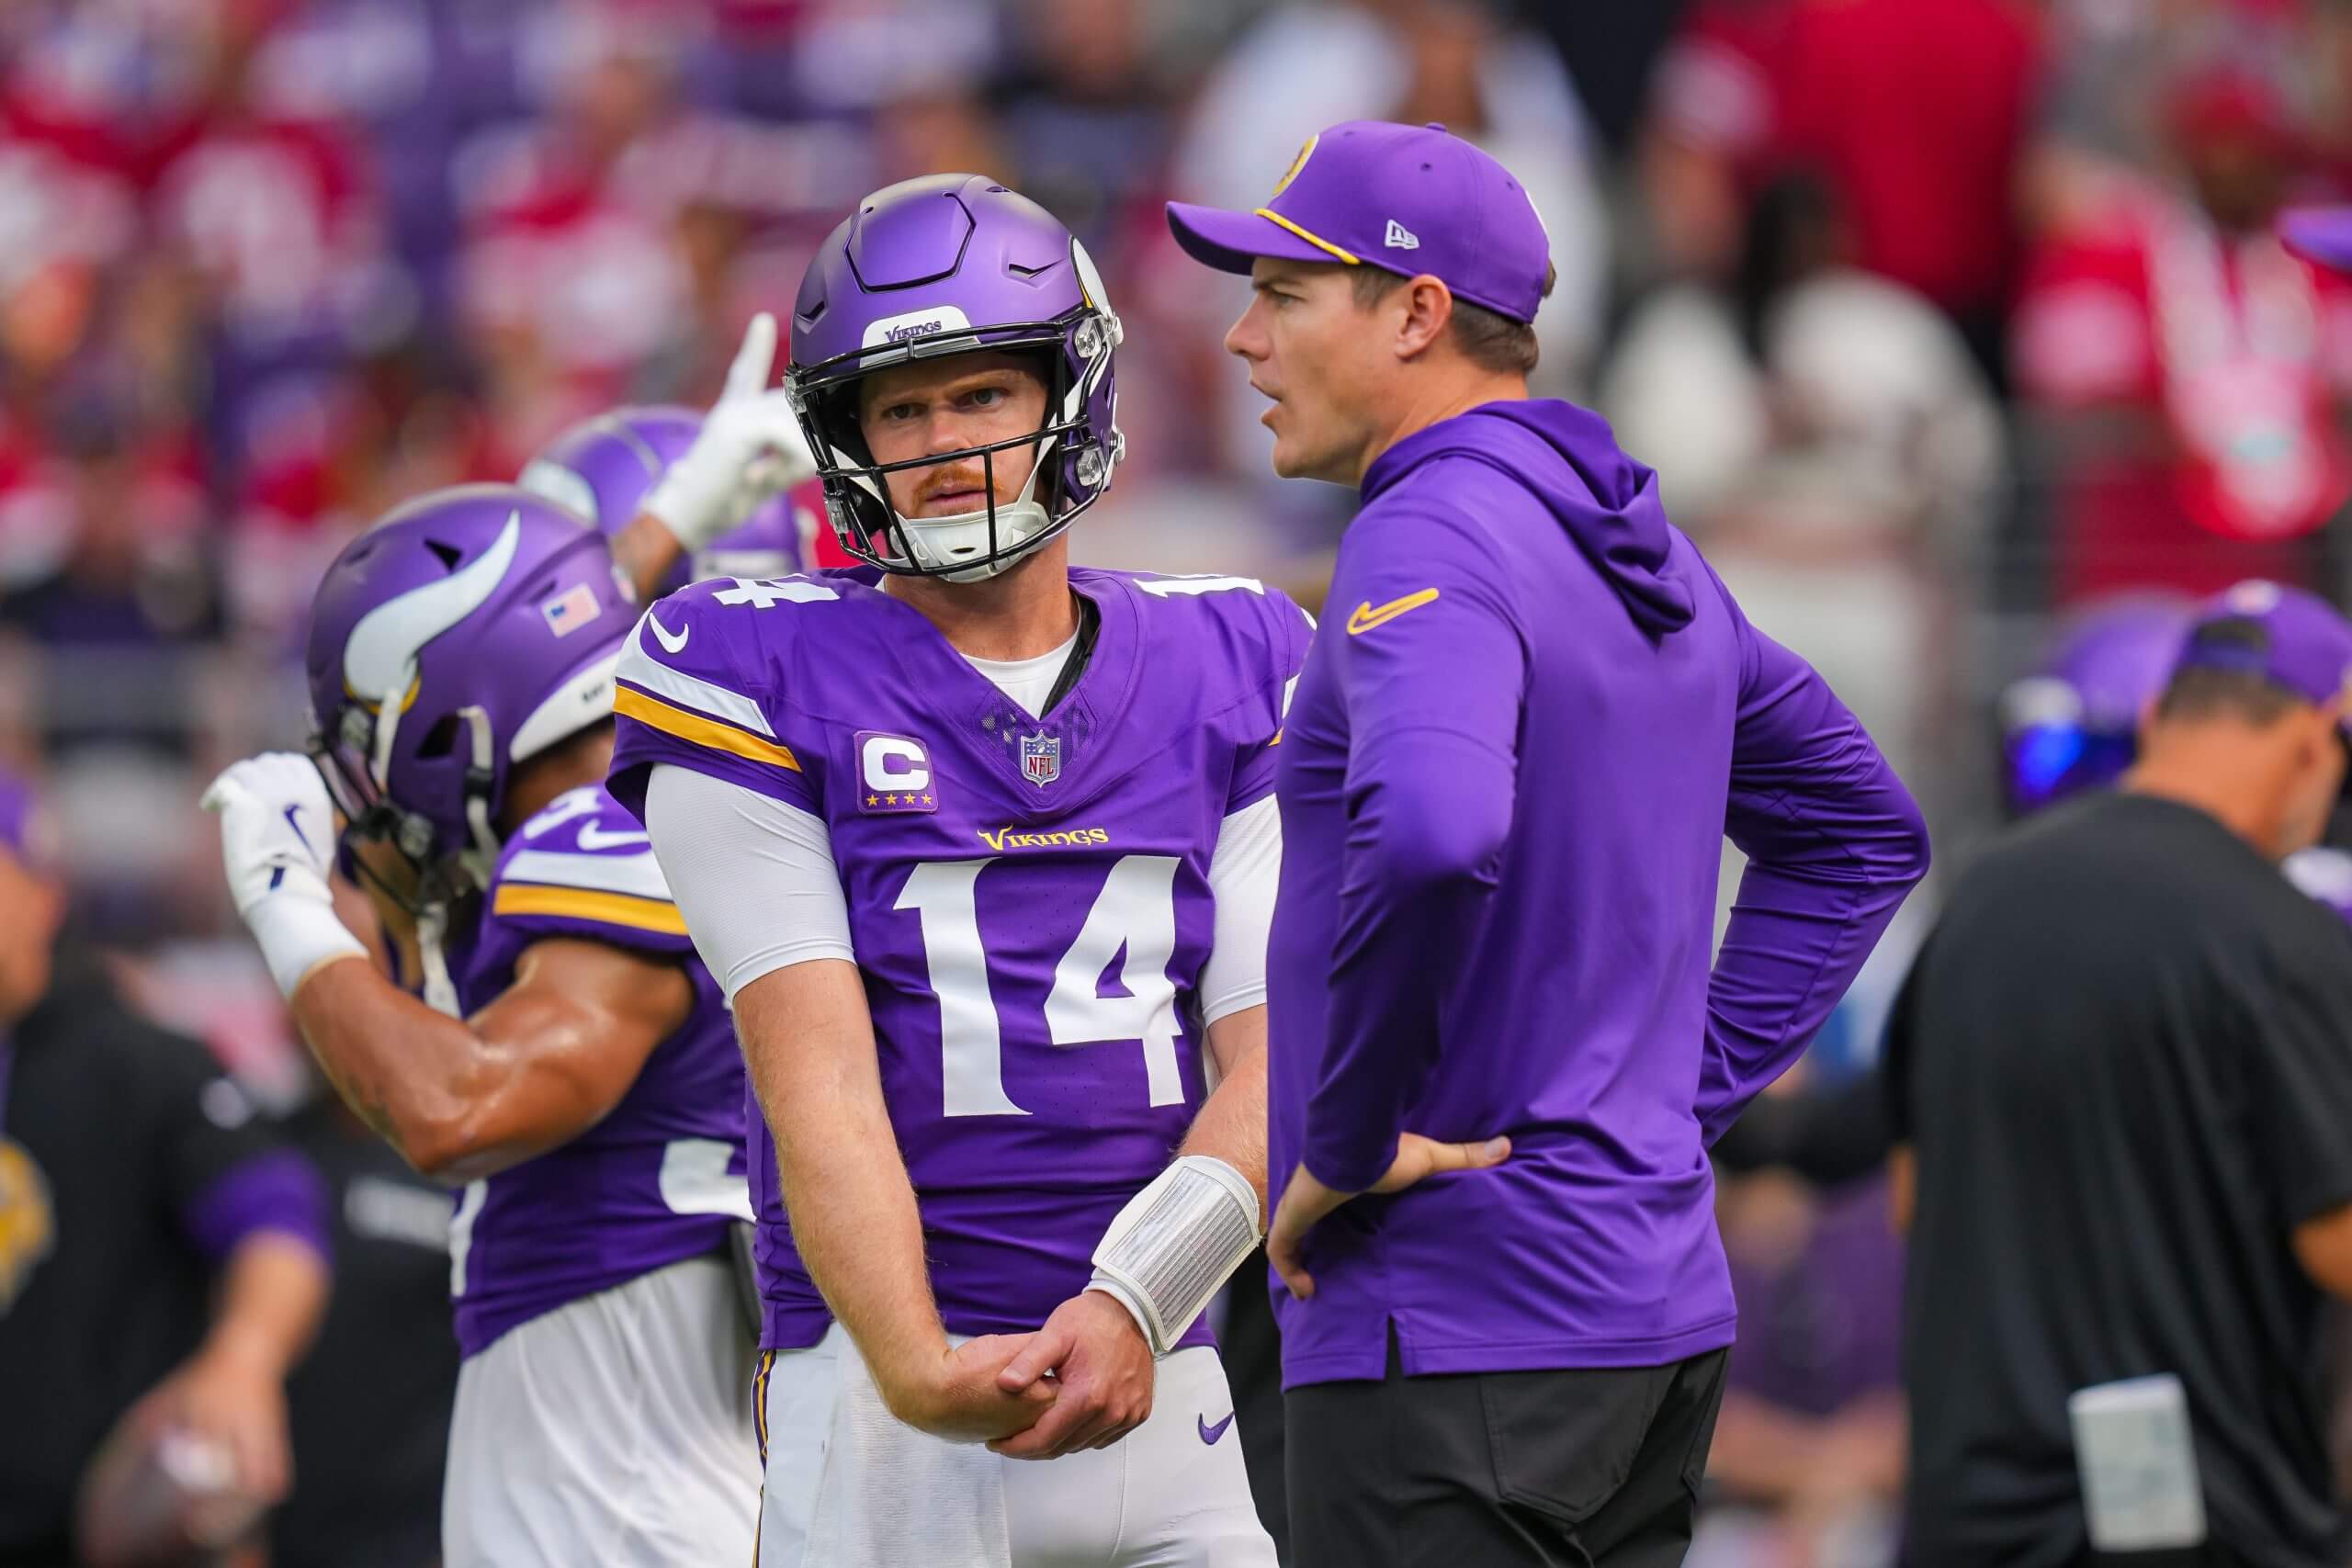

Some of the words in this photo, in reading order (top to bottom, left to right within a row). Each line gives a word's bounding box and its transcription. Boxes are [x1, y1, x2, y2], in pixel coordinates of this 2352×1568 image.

[862, 737, 930, 792] C
[1027, 755, 1055, 777] NFL
[892, 854, 1186, 1118] 14
